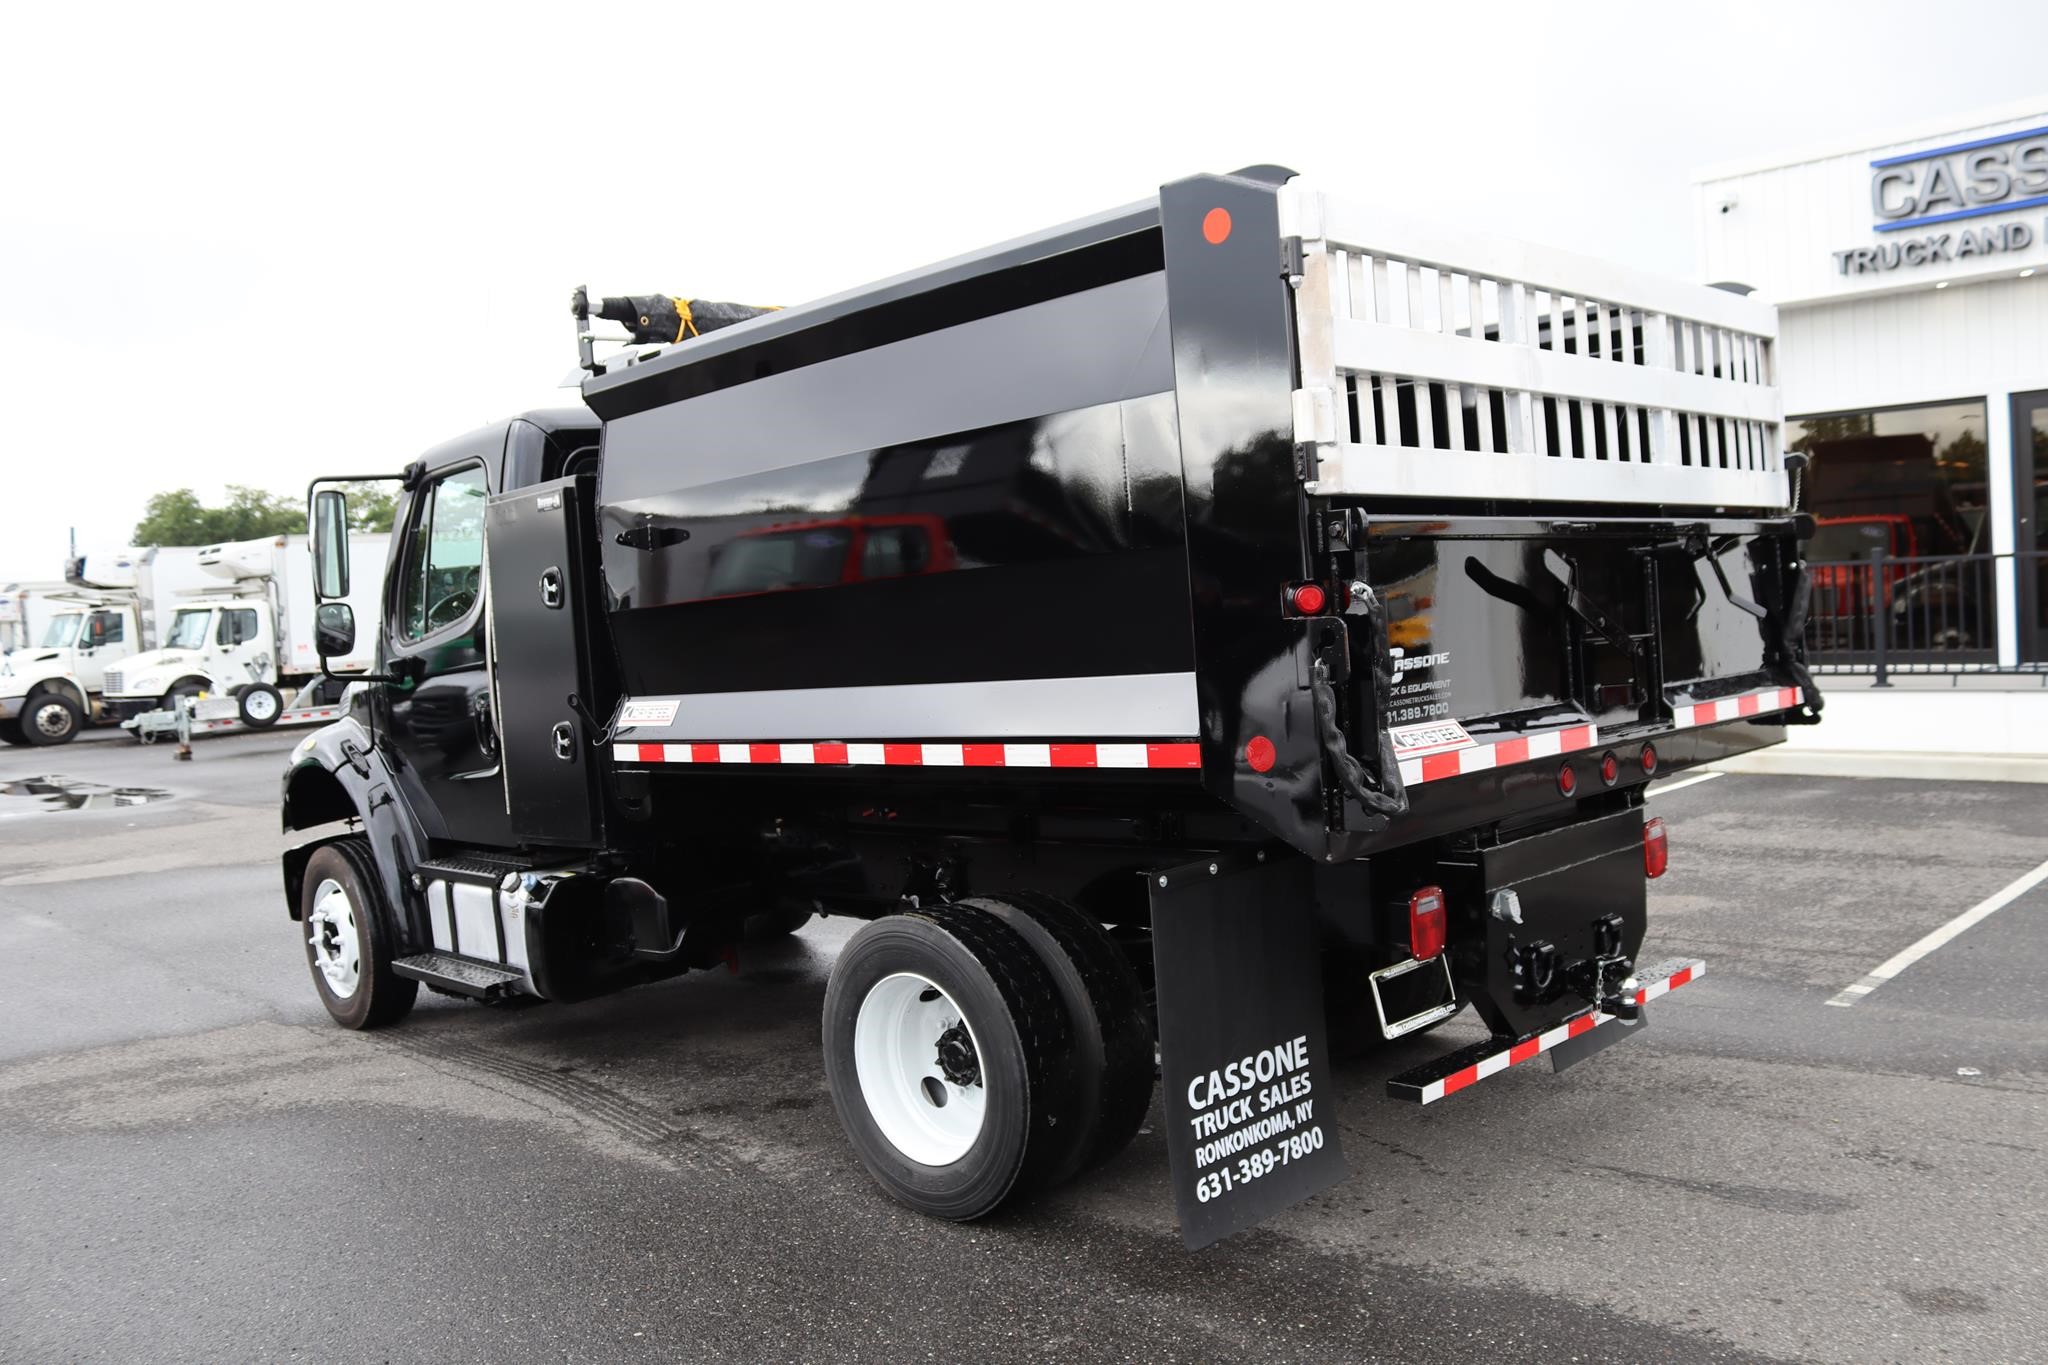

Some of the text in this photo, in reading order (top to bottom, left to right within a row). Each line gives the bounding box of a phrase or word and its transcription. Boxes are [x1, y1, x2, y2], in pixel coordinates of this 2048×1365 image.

[1871, 137, 2048, 220] CASS
[1832, 234, 1951, 275] TRUCK
[1955, 222, 2033, 259] AND
[1407, 679, 1451, 694] EQUIPMENT
[1401, 728, 1465, 747] CRYSTEEL
[1187, 1035, 1310, 1110] CASSONE
[1190, 1072, 1312, 1140] TRUCK SALES
[1195, 1099, 1314, 1169] RONKONKOMA, NY
[1196, 1126, 1324, 1203] 631-389-7800
